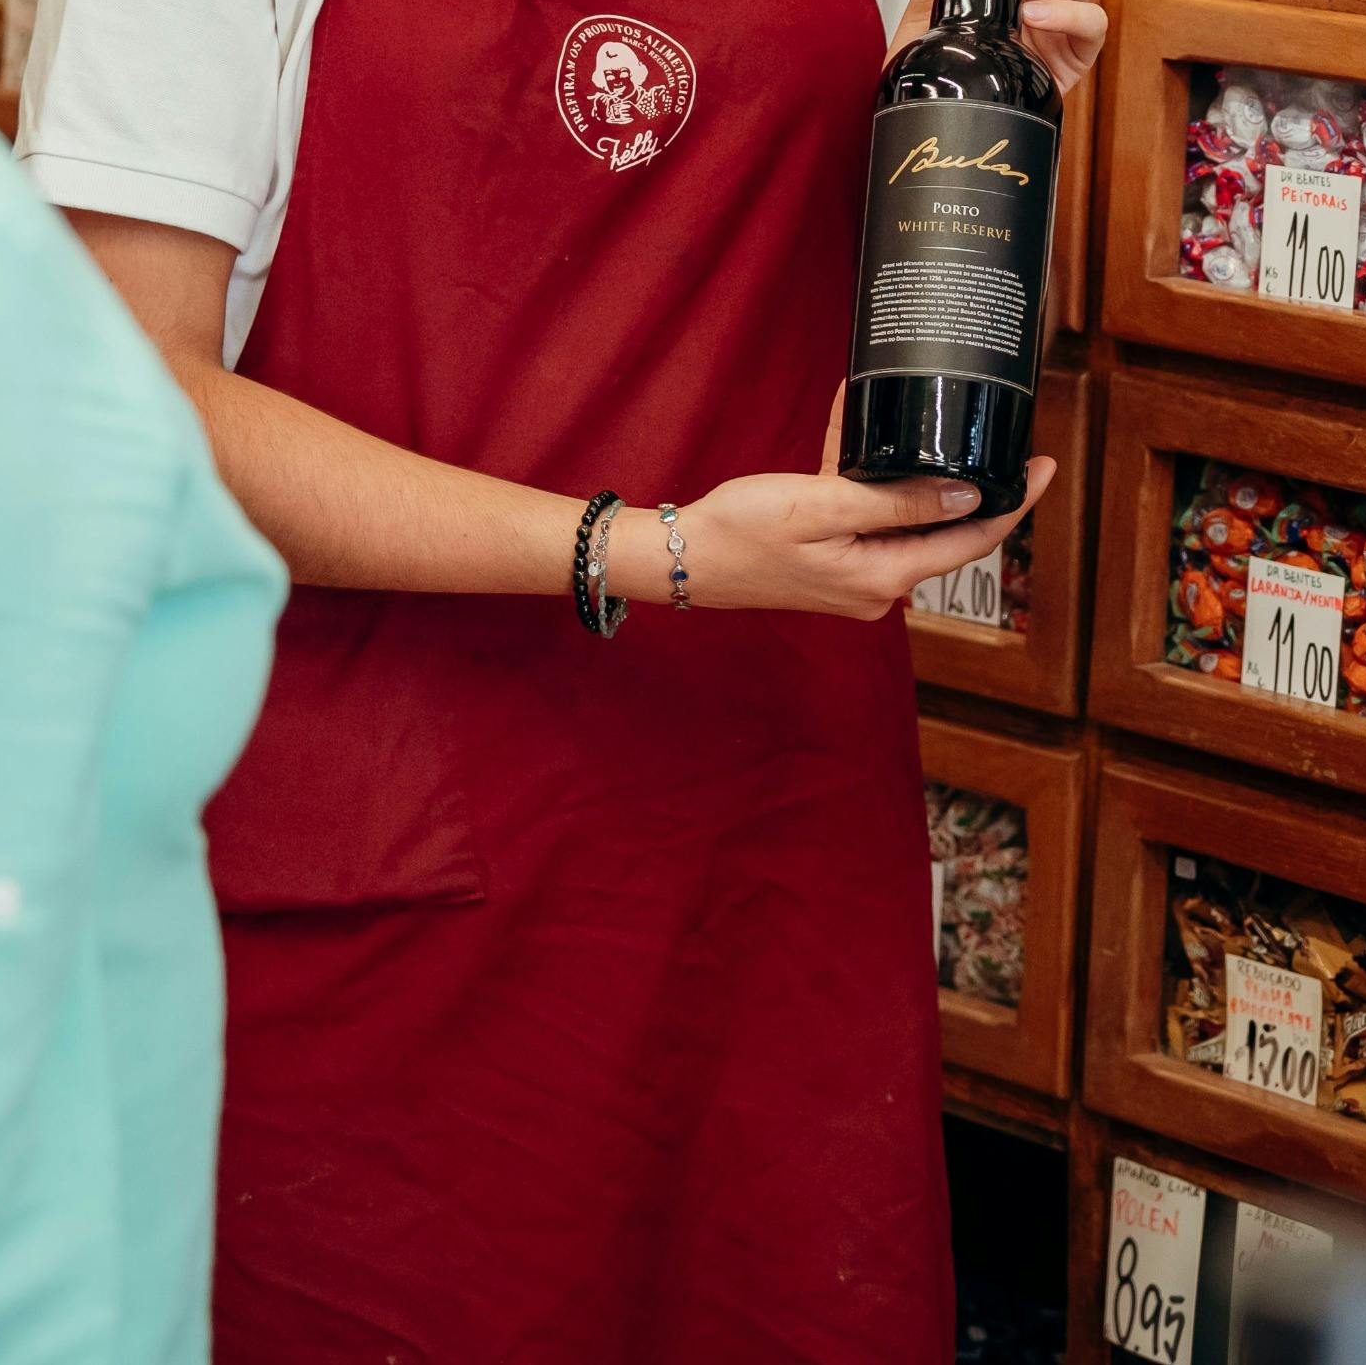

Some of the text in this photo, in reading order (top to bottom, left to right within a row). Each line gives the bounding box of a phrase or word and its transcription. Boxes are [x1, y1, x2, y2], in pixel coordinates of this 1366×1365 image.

[569, 41, 583, 59] OS
[578, 23, 642, 44] PRODUTOS
[621, 36, 676, 88] MARCA REGISTADA
[563, 59, 589, 133] PREFIRAM
[888, 136, 1029, 186] Bulas
[1281, 171, 1332, 187] DR BENTES
[1286, 211, 1345, 303] 11.00
[1266, 565, 1322, 589] DR BENTES
[1268, 606, 1333, 702] 11.00
